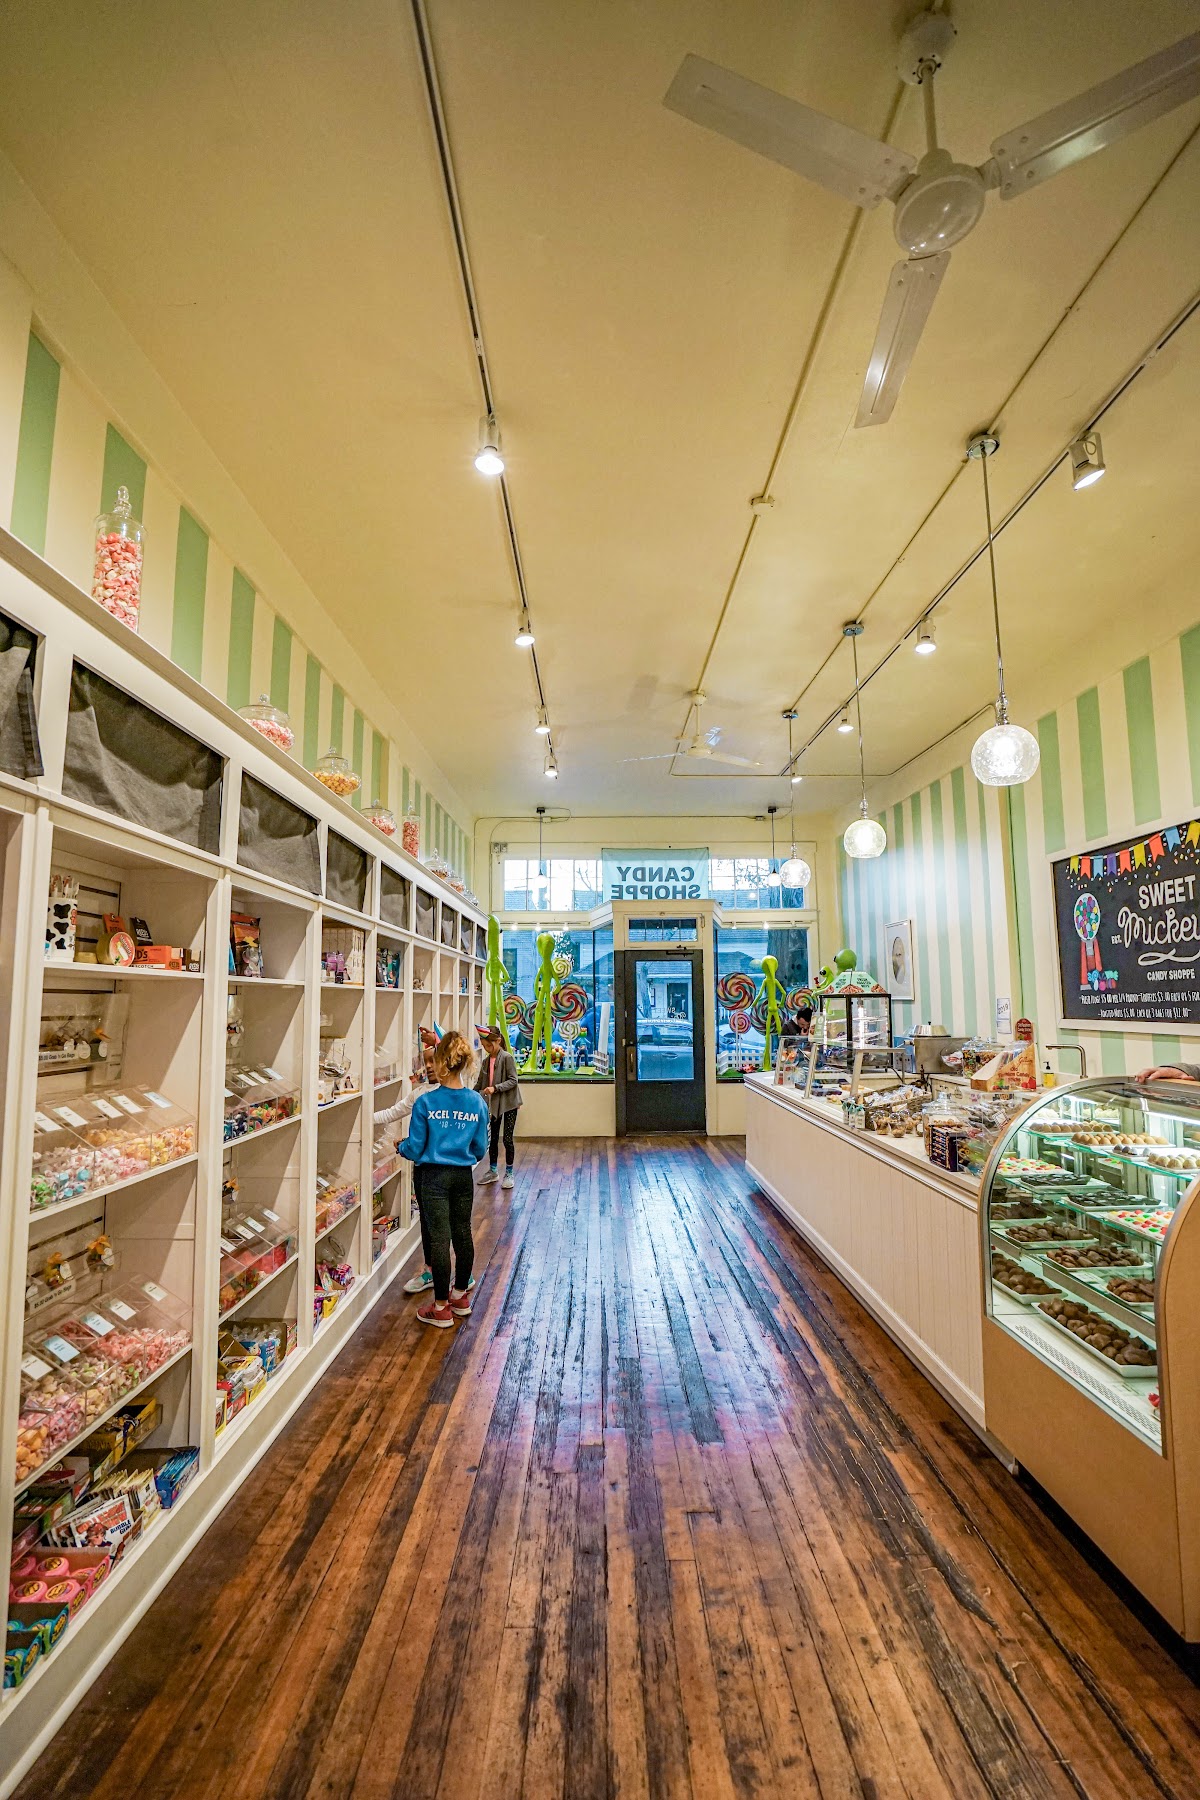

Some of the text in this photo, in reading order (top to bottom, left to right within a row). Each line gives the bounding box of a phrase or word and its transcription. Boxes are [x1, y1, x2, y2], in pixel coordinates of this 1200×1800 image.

[1138, 874, 1196, 910] SWEET
[1146, 968, 1196, 981] CANDY SHOPPE
[427, 1109, 479, 1122] XCEL TEAM
